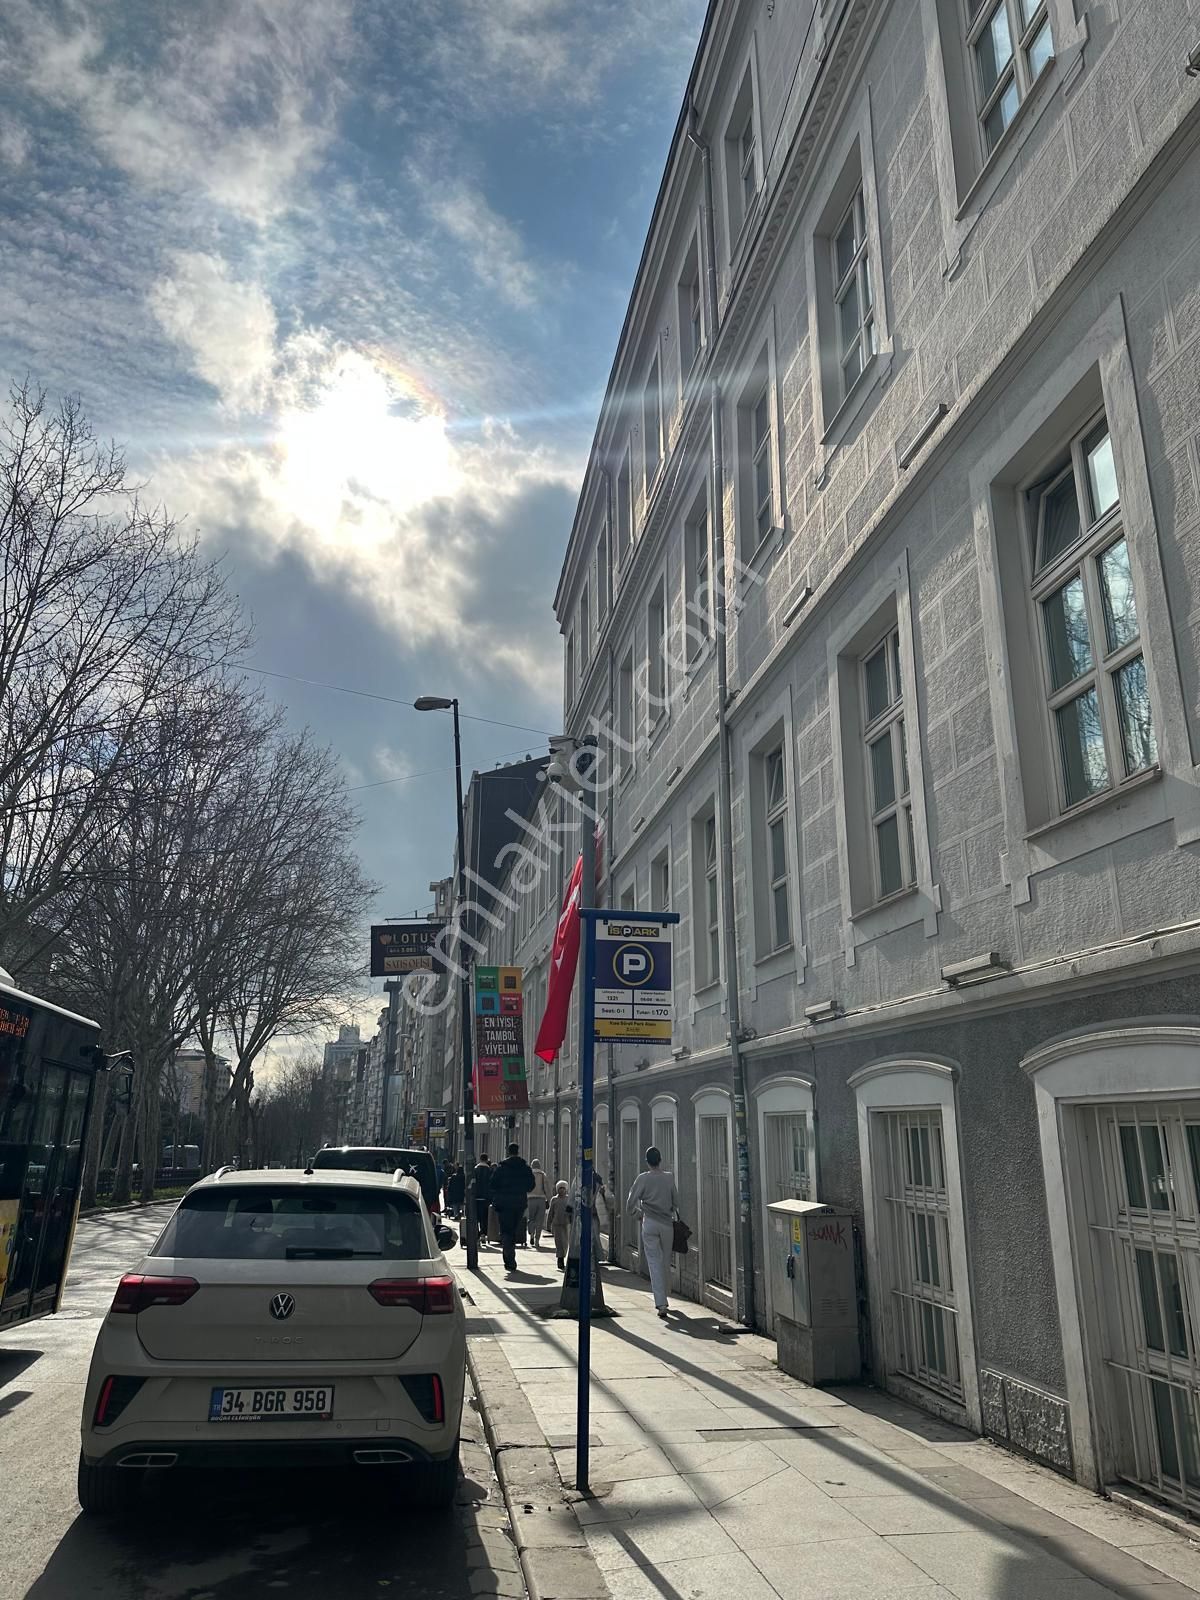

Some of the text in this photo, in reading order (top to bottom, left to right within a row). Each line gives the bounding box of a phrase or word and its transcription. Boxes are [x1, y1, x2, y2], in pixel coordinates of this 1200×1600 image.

[392, 932, 437, 944] LOTUS
[623, 953, 646, 975] P
[484, 1017, 495, 1028] EN
[486, 1030, 517, 1041] TAMBOL
[485, 1042, 519, 1055] YİYELİM!
[222, 1389, 327, 1413] 34 BGR 958
